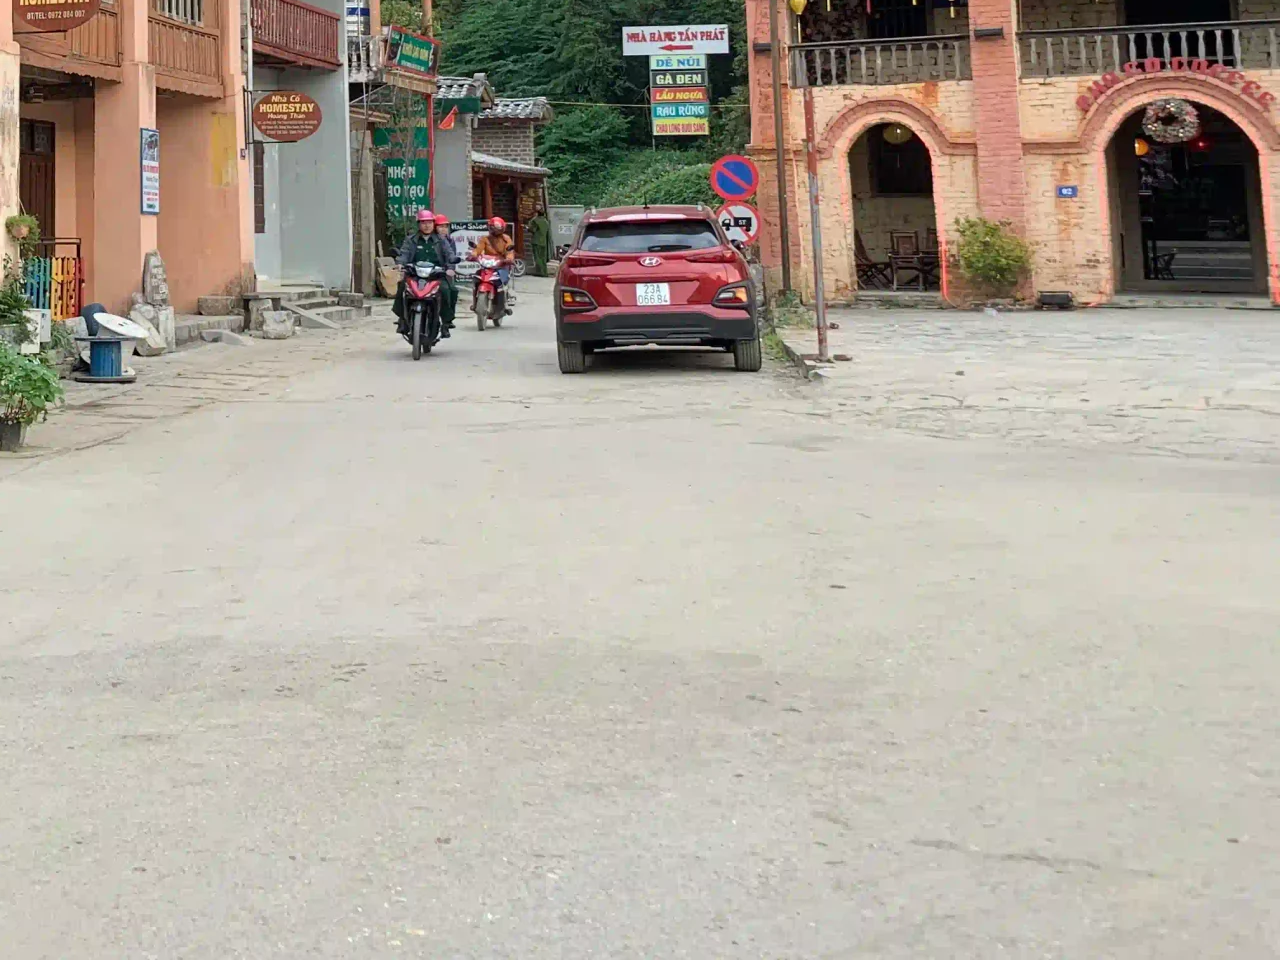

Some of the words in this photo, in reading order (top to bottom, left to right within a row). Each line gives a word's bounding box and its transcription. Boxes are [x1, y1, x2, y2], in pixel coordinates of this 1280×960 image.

[626, 30, 647, 43] NHÀ
[649, 29, 677, 42] HÀNG
[655, 73, 673, 84] GÀ
[259, 103, 315, 113] HOMESTAY
[656, 106, 676, 116] RAU
[643, 284, 661, 294] 23A
